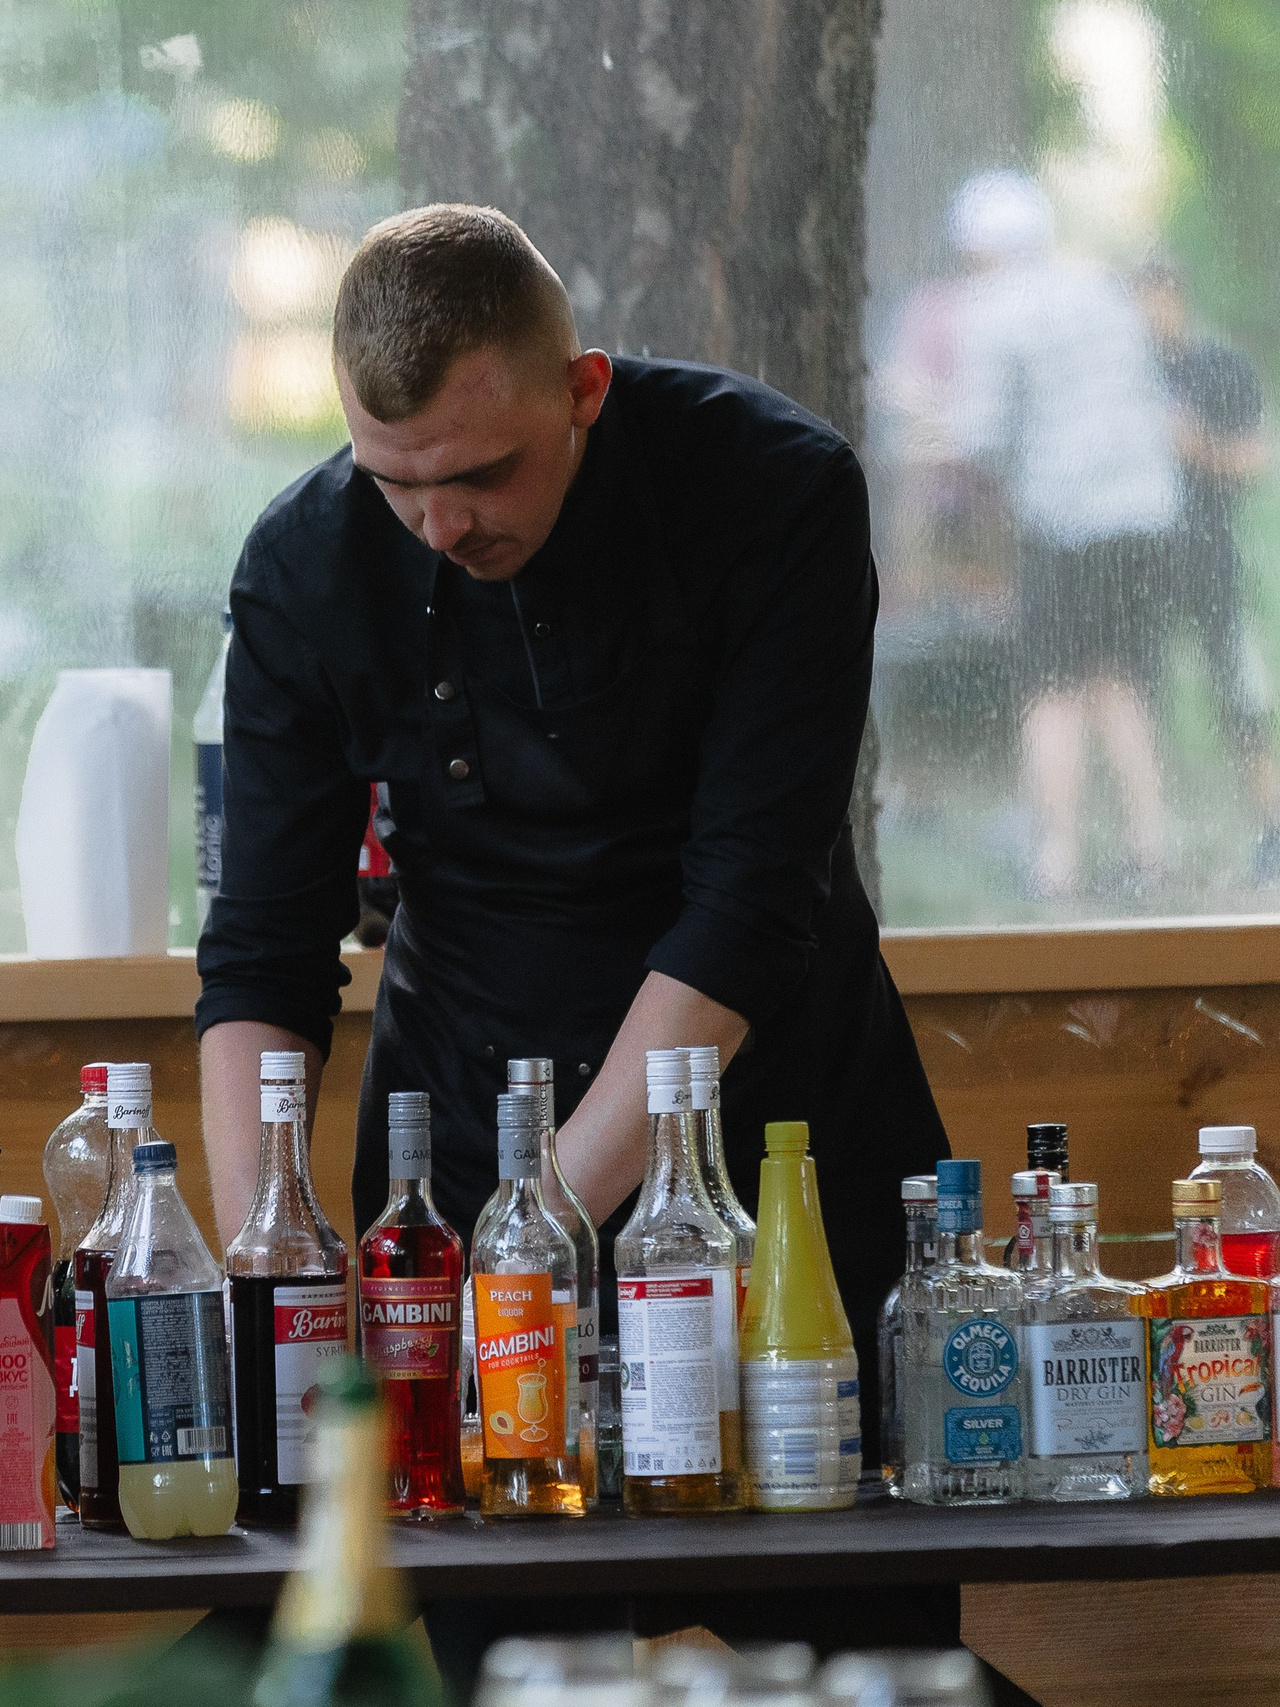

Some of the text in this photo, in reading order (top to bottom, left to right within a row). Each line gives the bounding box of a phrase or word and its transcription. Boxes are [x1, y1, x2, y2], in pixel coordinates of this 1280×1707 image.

[489, 1290, 533, 1303] PEACH
[497, 1308, 524, 1317] LIQUOR
[479, 1325, 555, 1362] GAMBINI
[952, 1325, 1008, 1351] OLMECA
[1194, 1338, 1242, 1354] BARRISTER
[488, 1352, 540, 1370] FOR COCKTAILS
[953, 1364, 1012, 1392] TEQUILA
[1043, 1356, 1142, 1387] BARRISTER
[1170, 1353, 1261, 1394] Tropical
[1056, 1384, 1131, 1402] DRY GIN
[1201, 1385, 1236, 1402] GIN
[963, 1419, 1004, 1430] SILVER
